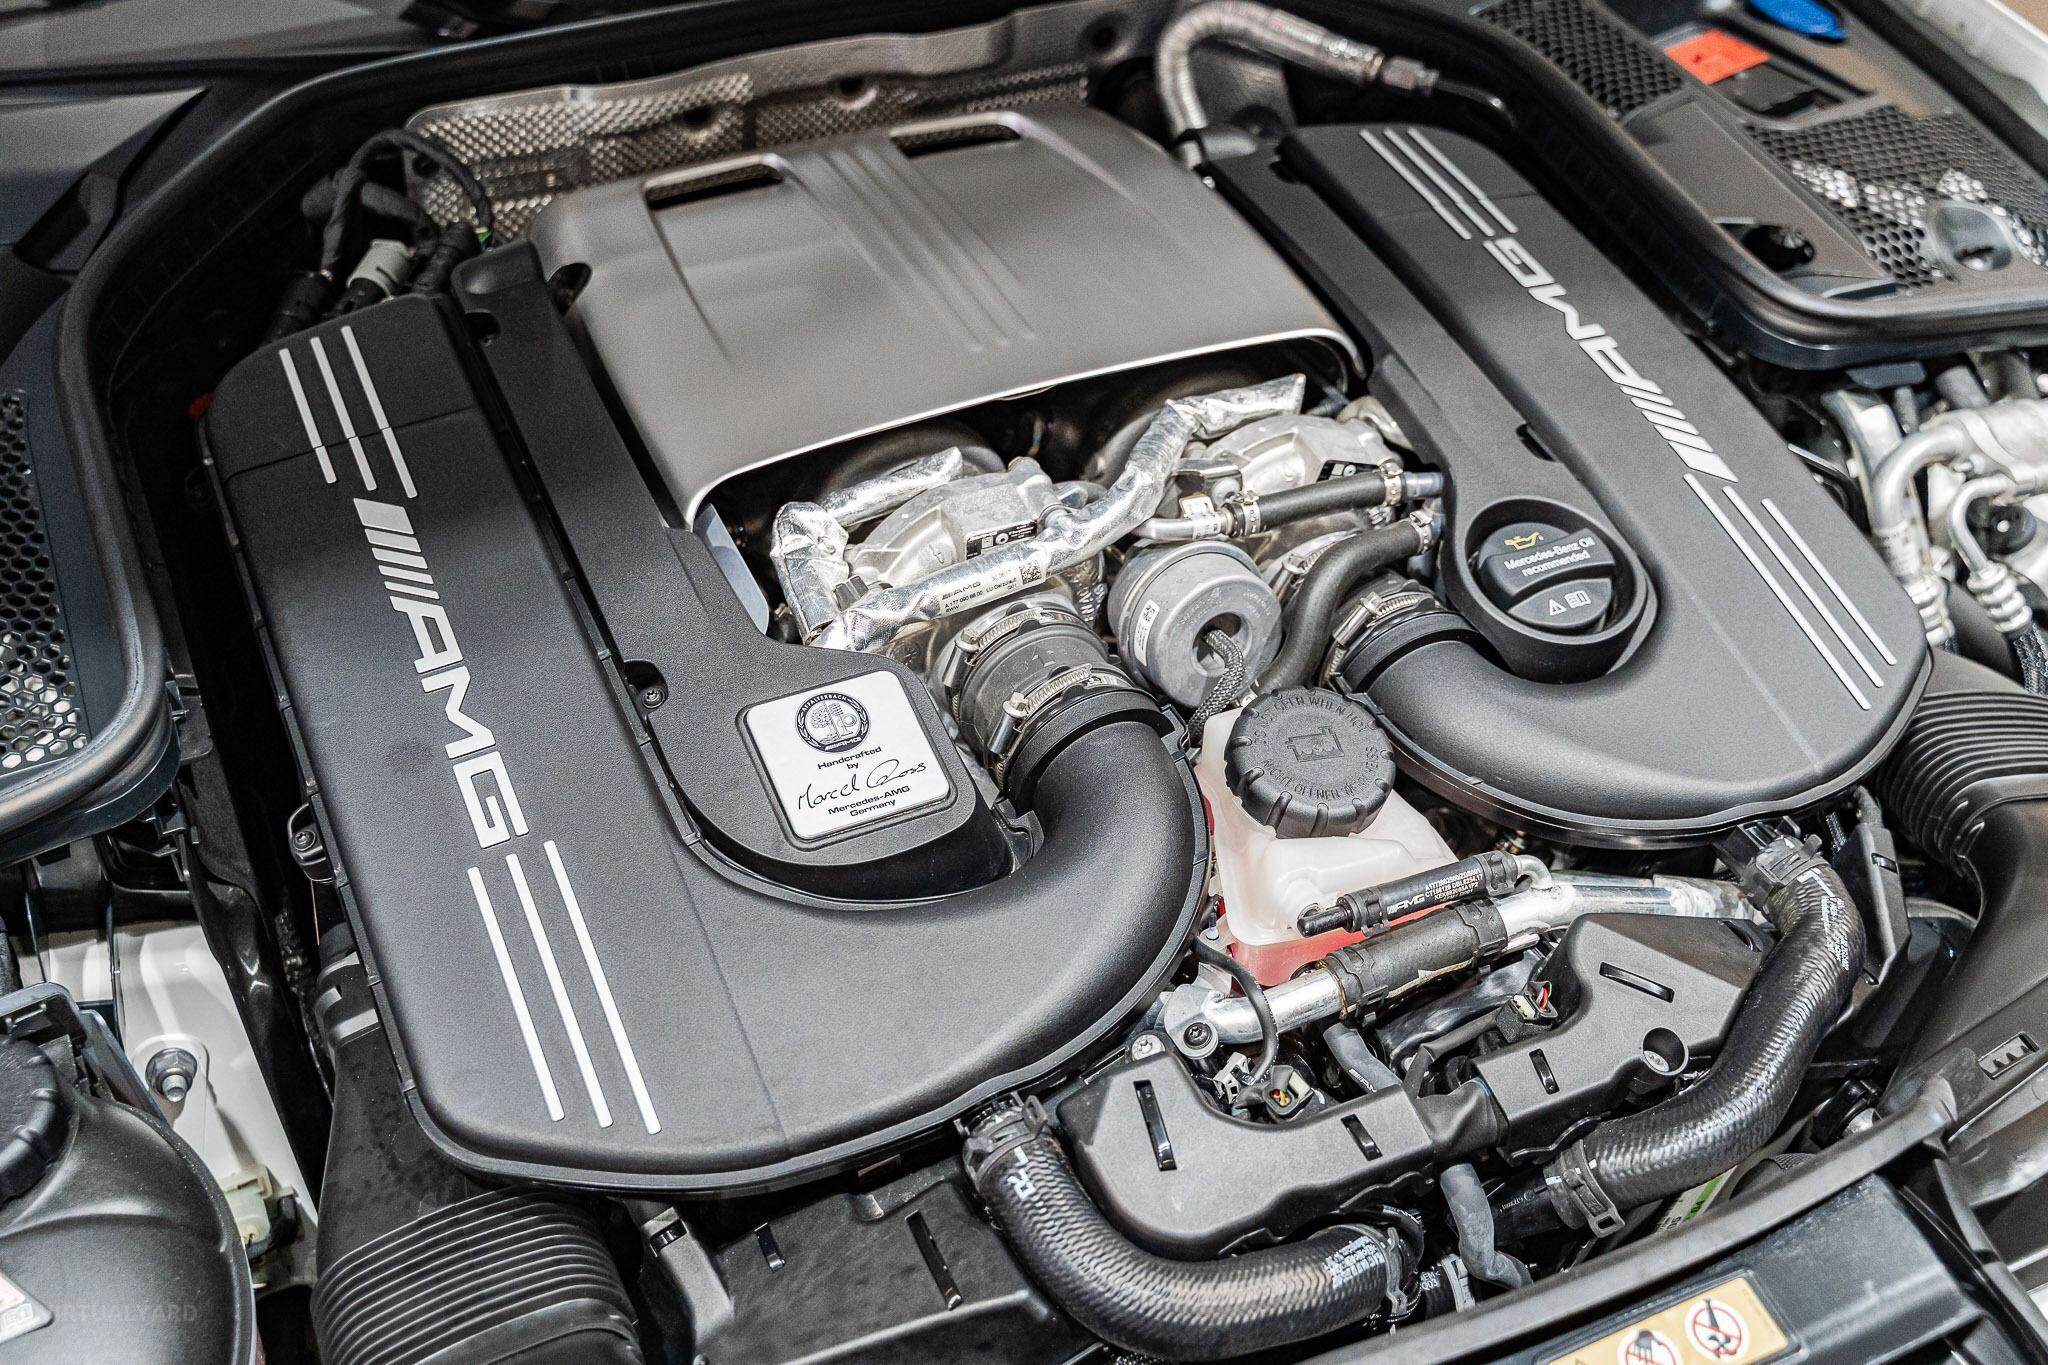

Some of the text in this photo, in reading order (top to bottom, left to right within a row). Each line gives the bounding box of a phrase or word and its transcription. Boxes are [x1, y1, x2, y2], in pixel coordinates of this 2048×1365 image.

[1504, 537, 1596, 570] Mercedes-Benz Oil
[1522, 550, 1590, 576] recommended
[801, 692, 848, 712] AFFALTERBACH
[390, 595, 530, 849] AMG
[817, 746, 882, 770] Handcrafted
[847, 762, 859, 770] by
[798, 774, 860, 810] Marcel
[828, 785, 910, 815] Mercedes-AMG
[849, 799, 896, 818] Germany
